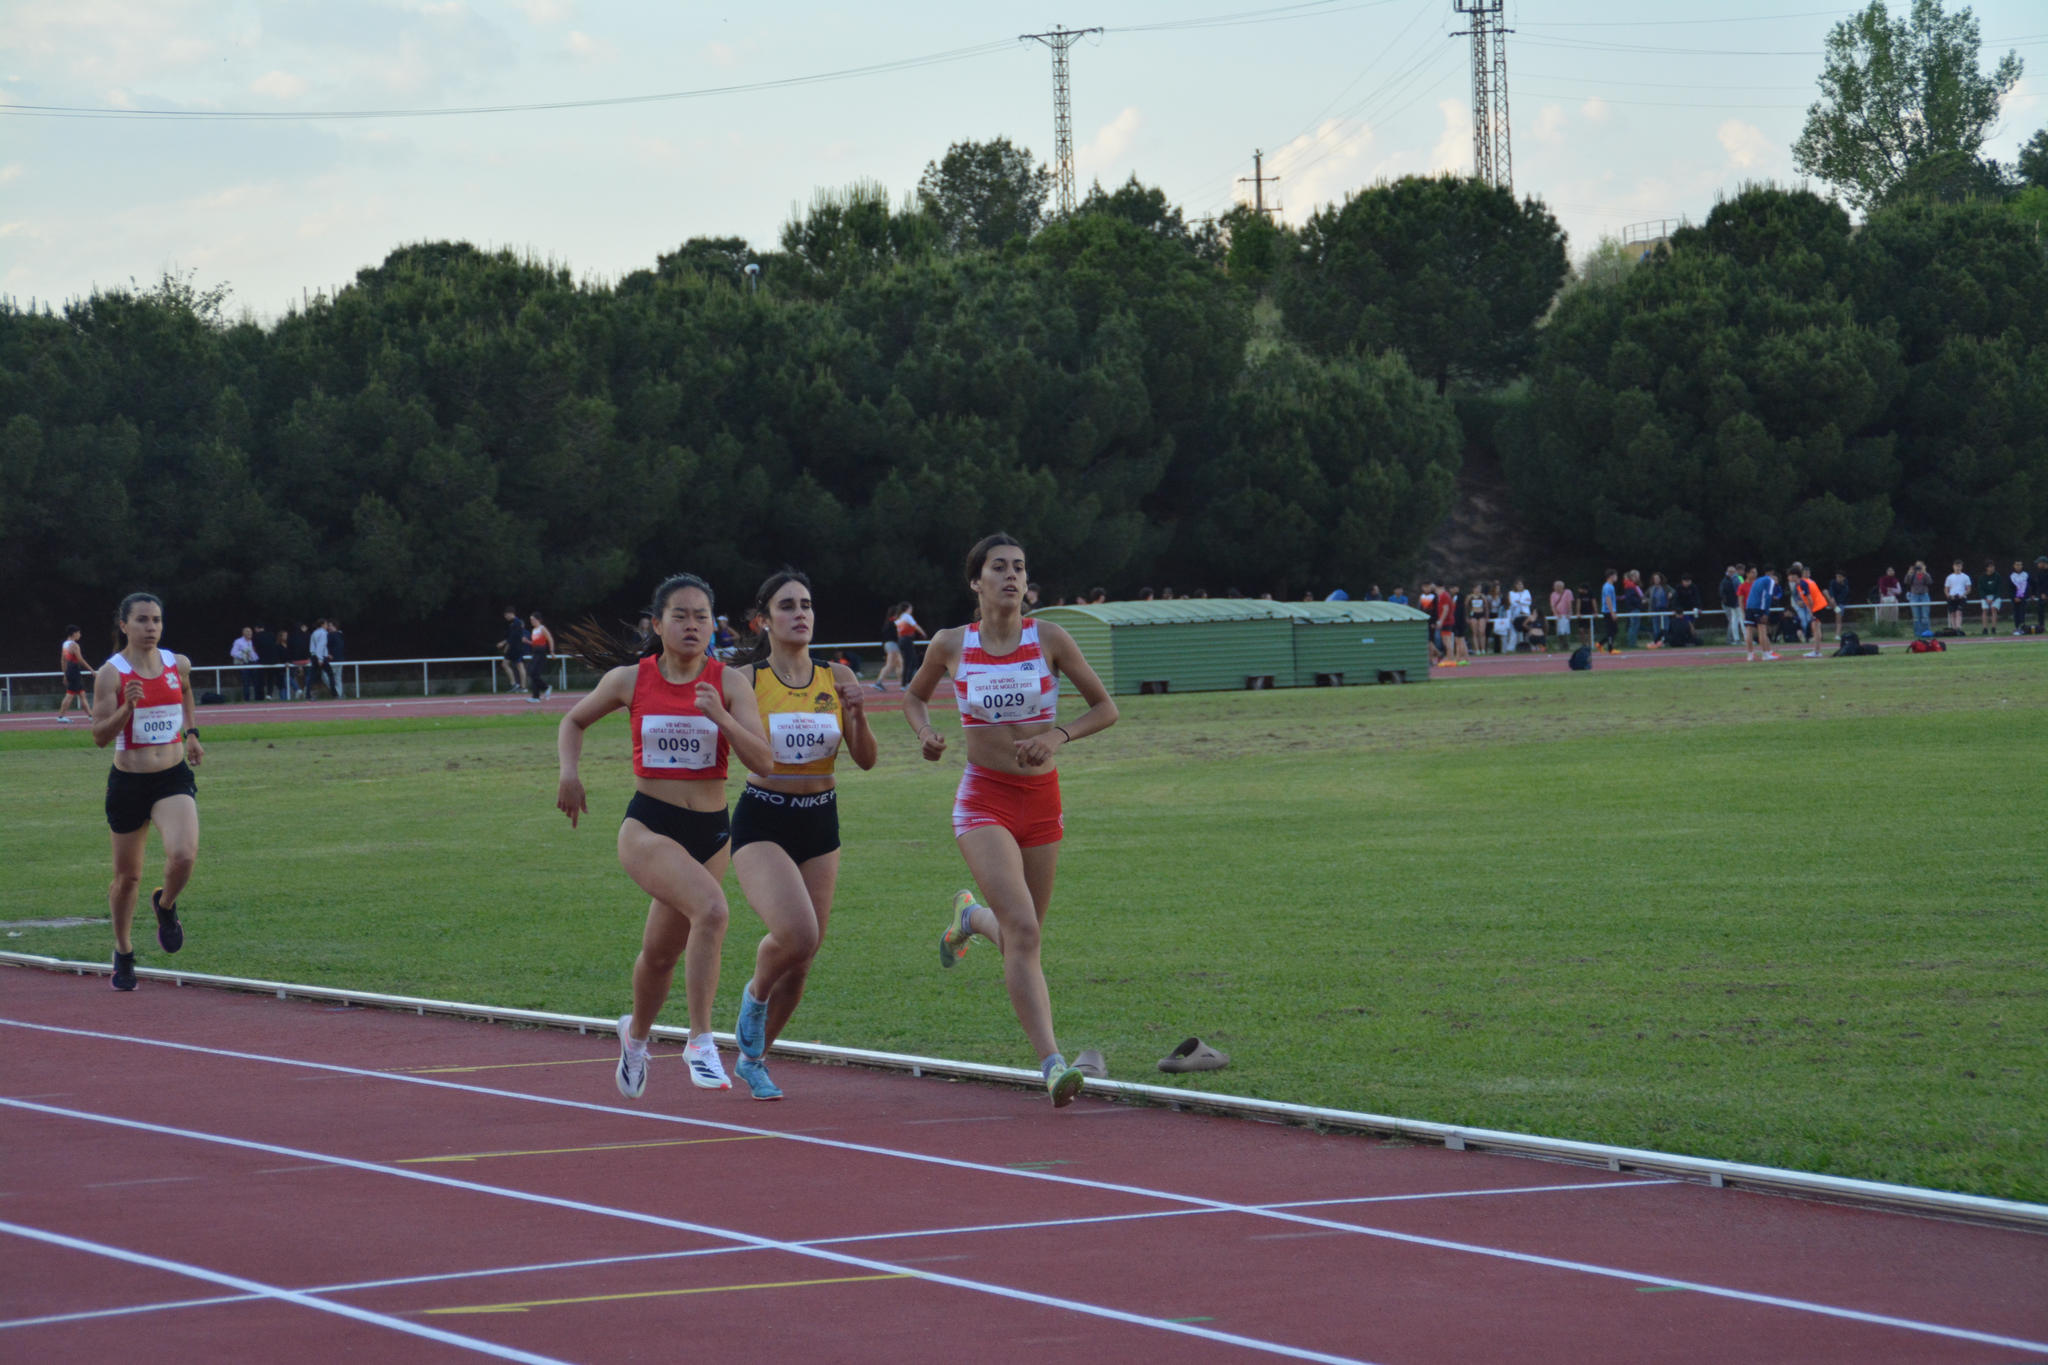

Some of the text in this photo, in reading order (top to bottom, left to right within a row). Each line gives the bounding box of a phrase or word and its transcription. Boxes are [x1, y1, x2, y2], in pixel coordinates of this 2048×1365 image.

[983, 693, 1024, 709] 0029
[144, 720, 173, 732] 0003
[658, 738, 700, 753] 0099
[786, 732, 825, 748] 0084
[746, 786, 785, 805] PRO
[790, 793, 828, 808] NIKE
